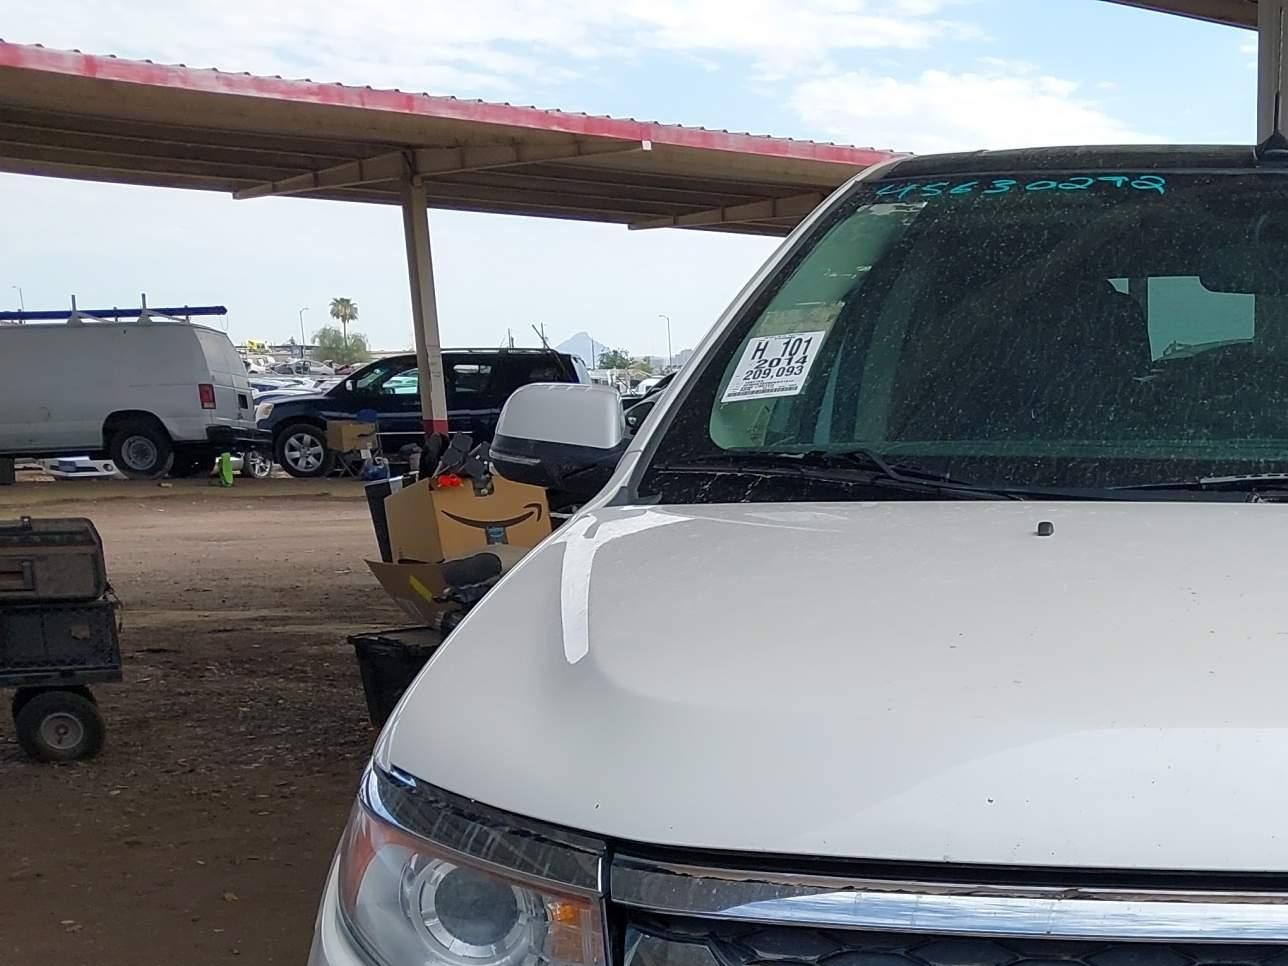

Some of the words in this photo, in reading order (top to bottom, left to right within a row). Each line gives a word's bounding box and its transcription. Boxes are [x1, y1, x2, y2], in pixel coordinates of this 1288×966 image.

[751, 341, 769, 360] H
[781, 337, 813, 357] 101
[754, 355, 808, 369] 2014
[743, 366, 803, 380] 209,093
